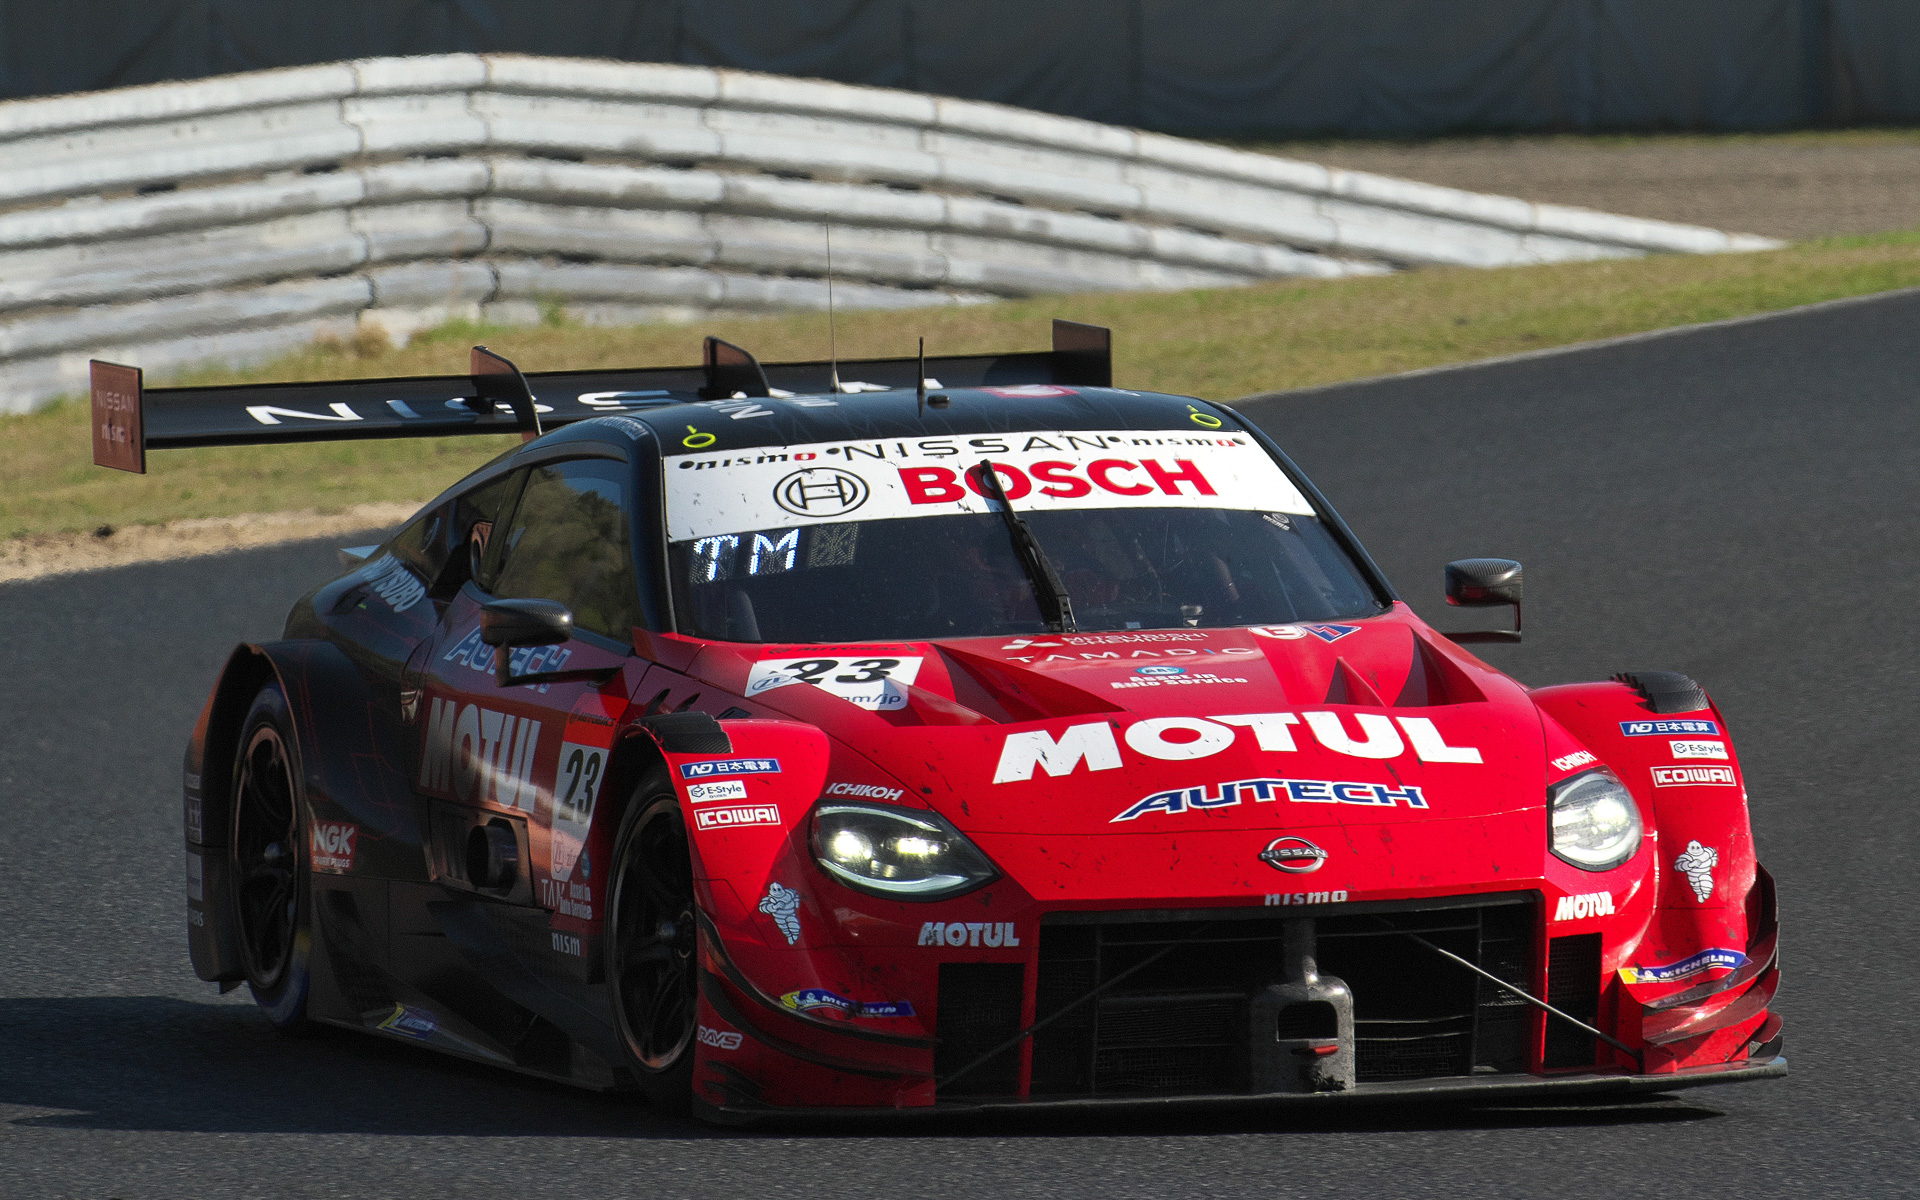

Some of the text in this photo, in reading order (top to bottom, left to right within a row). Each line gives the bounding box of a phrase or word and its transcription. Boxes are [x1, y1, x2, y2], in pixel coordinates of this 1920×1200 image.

[843, 434, 1110, 461] NISSAN
[1130, 437, 1236, 447] nismo
[694, 453, 817, 470] nismo
[898, 458, 1218, 505] BOSCH
[1006, 647, 1255, 663] TAMADIC
[783, 659, 900, 685] 23
[419, 697, 541, 814] MOTUL
[993, 712, 1483, 785] MOTUL
[1551, 750, 1598, 772] ICHIKOH
[558, 748, 601, 824] 23
[1655, 769, 1732, 784] KOIWAI
[706, 784, 743, 795] E-Style
[826, 782, 904, 801] ICHIKOH
[1108, 777, 1430, 823] AUTECH
[698, 808, 777, 827] KOIWAI
[313, 824, 355, 855] NGK
[1260, 848, 1327, 859] NISSAN
[1264, 890, 1348, 907] nismo
[1554, 891, 1616, 921] MOTUL
[917, 922, 1020, 947] MOTUL
[1659, 954, 1736, 979] MICHELIN
[821, 994, 898, 1014] MICLIN
[698, 1025, 743, 1050] RAYS
